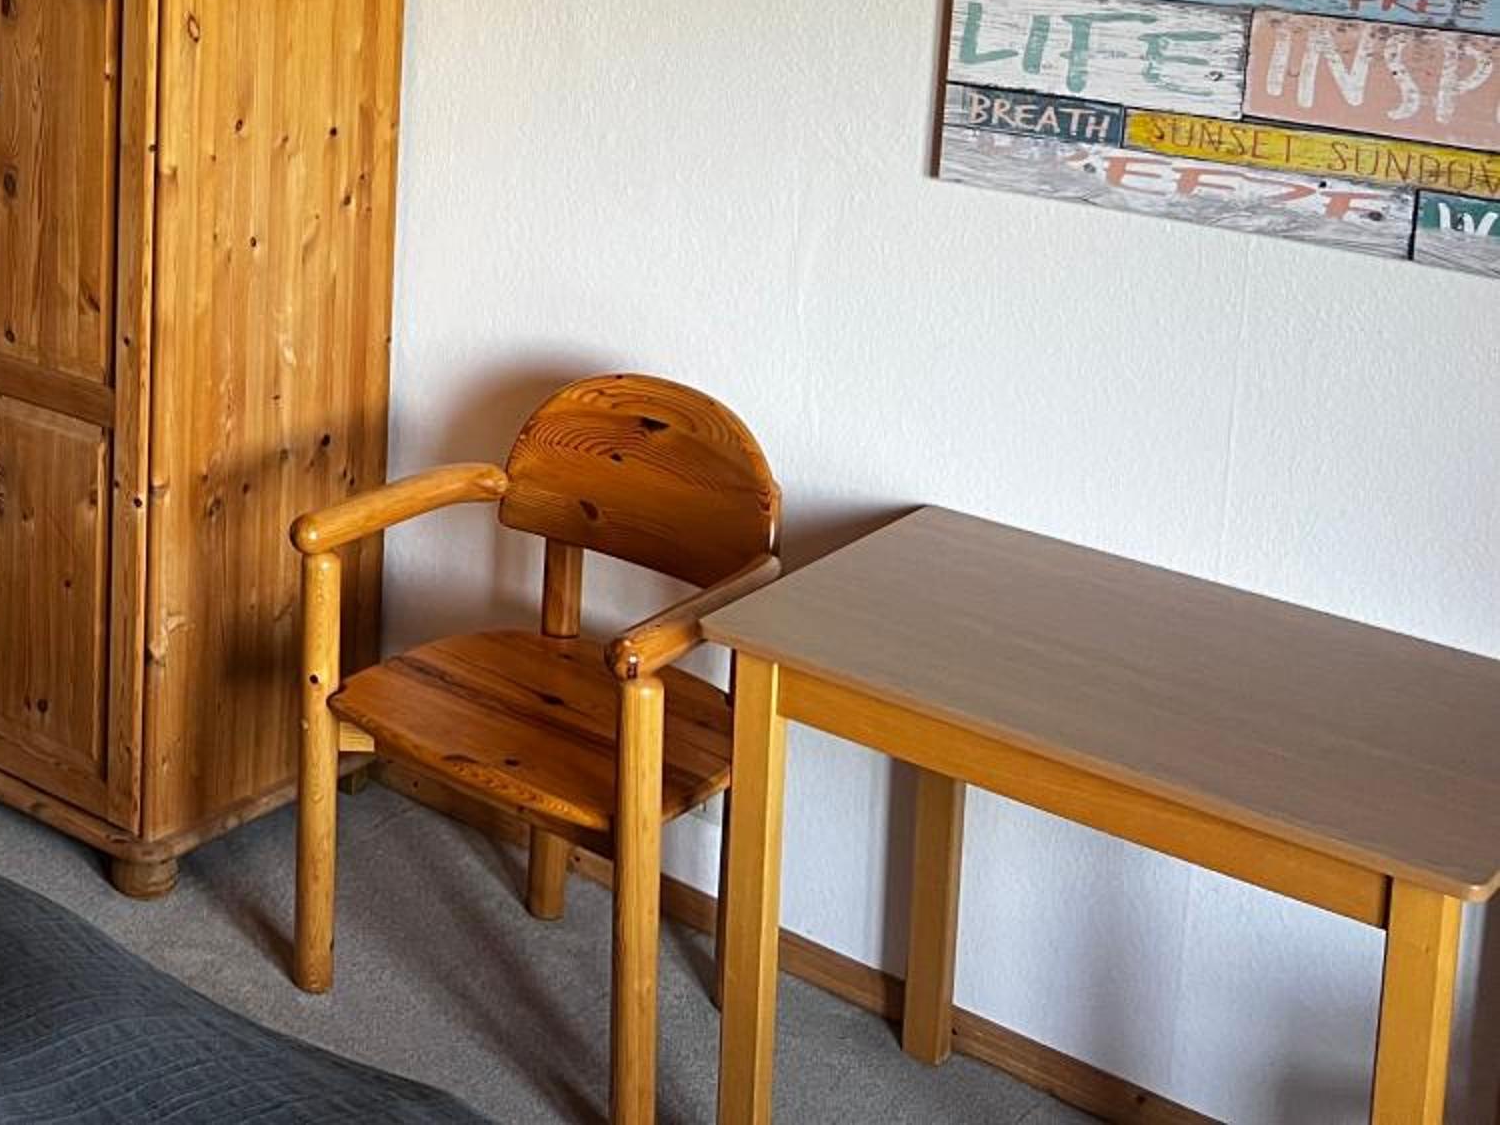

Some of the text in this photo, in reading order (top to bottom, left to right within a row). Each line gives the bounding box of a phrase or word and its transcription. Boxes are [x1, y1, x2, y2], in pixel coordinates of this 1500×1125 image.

[959, 1, 1222, 97] LIFE
[1266, 25, 1500, 124] INSP
[967, 91, 1110, 138] BREATH
[1151, 116, 1292, 164] SUNSET
